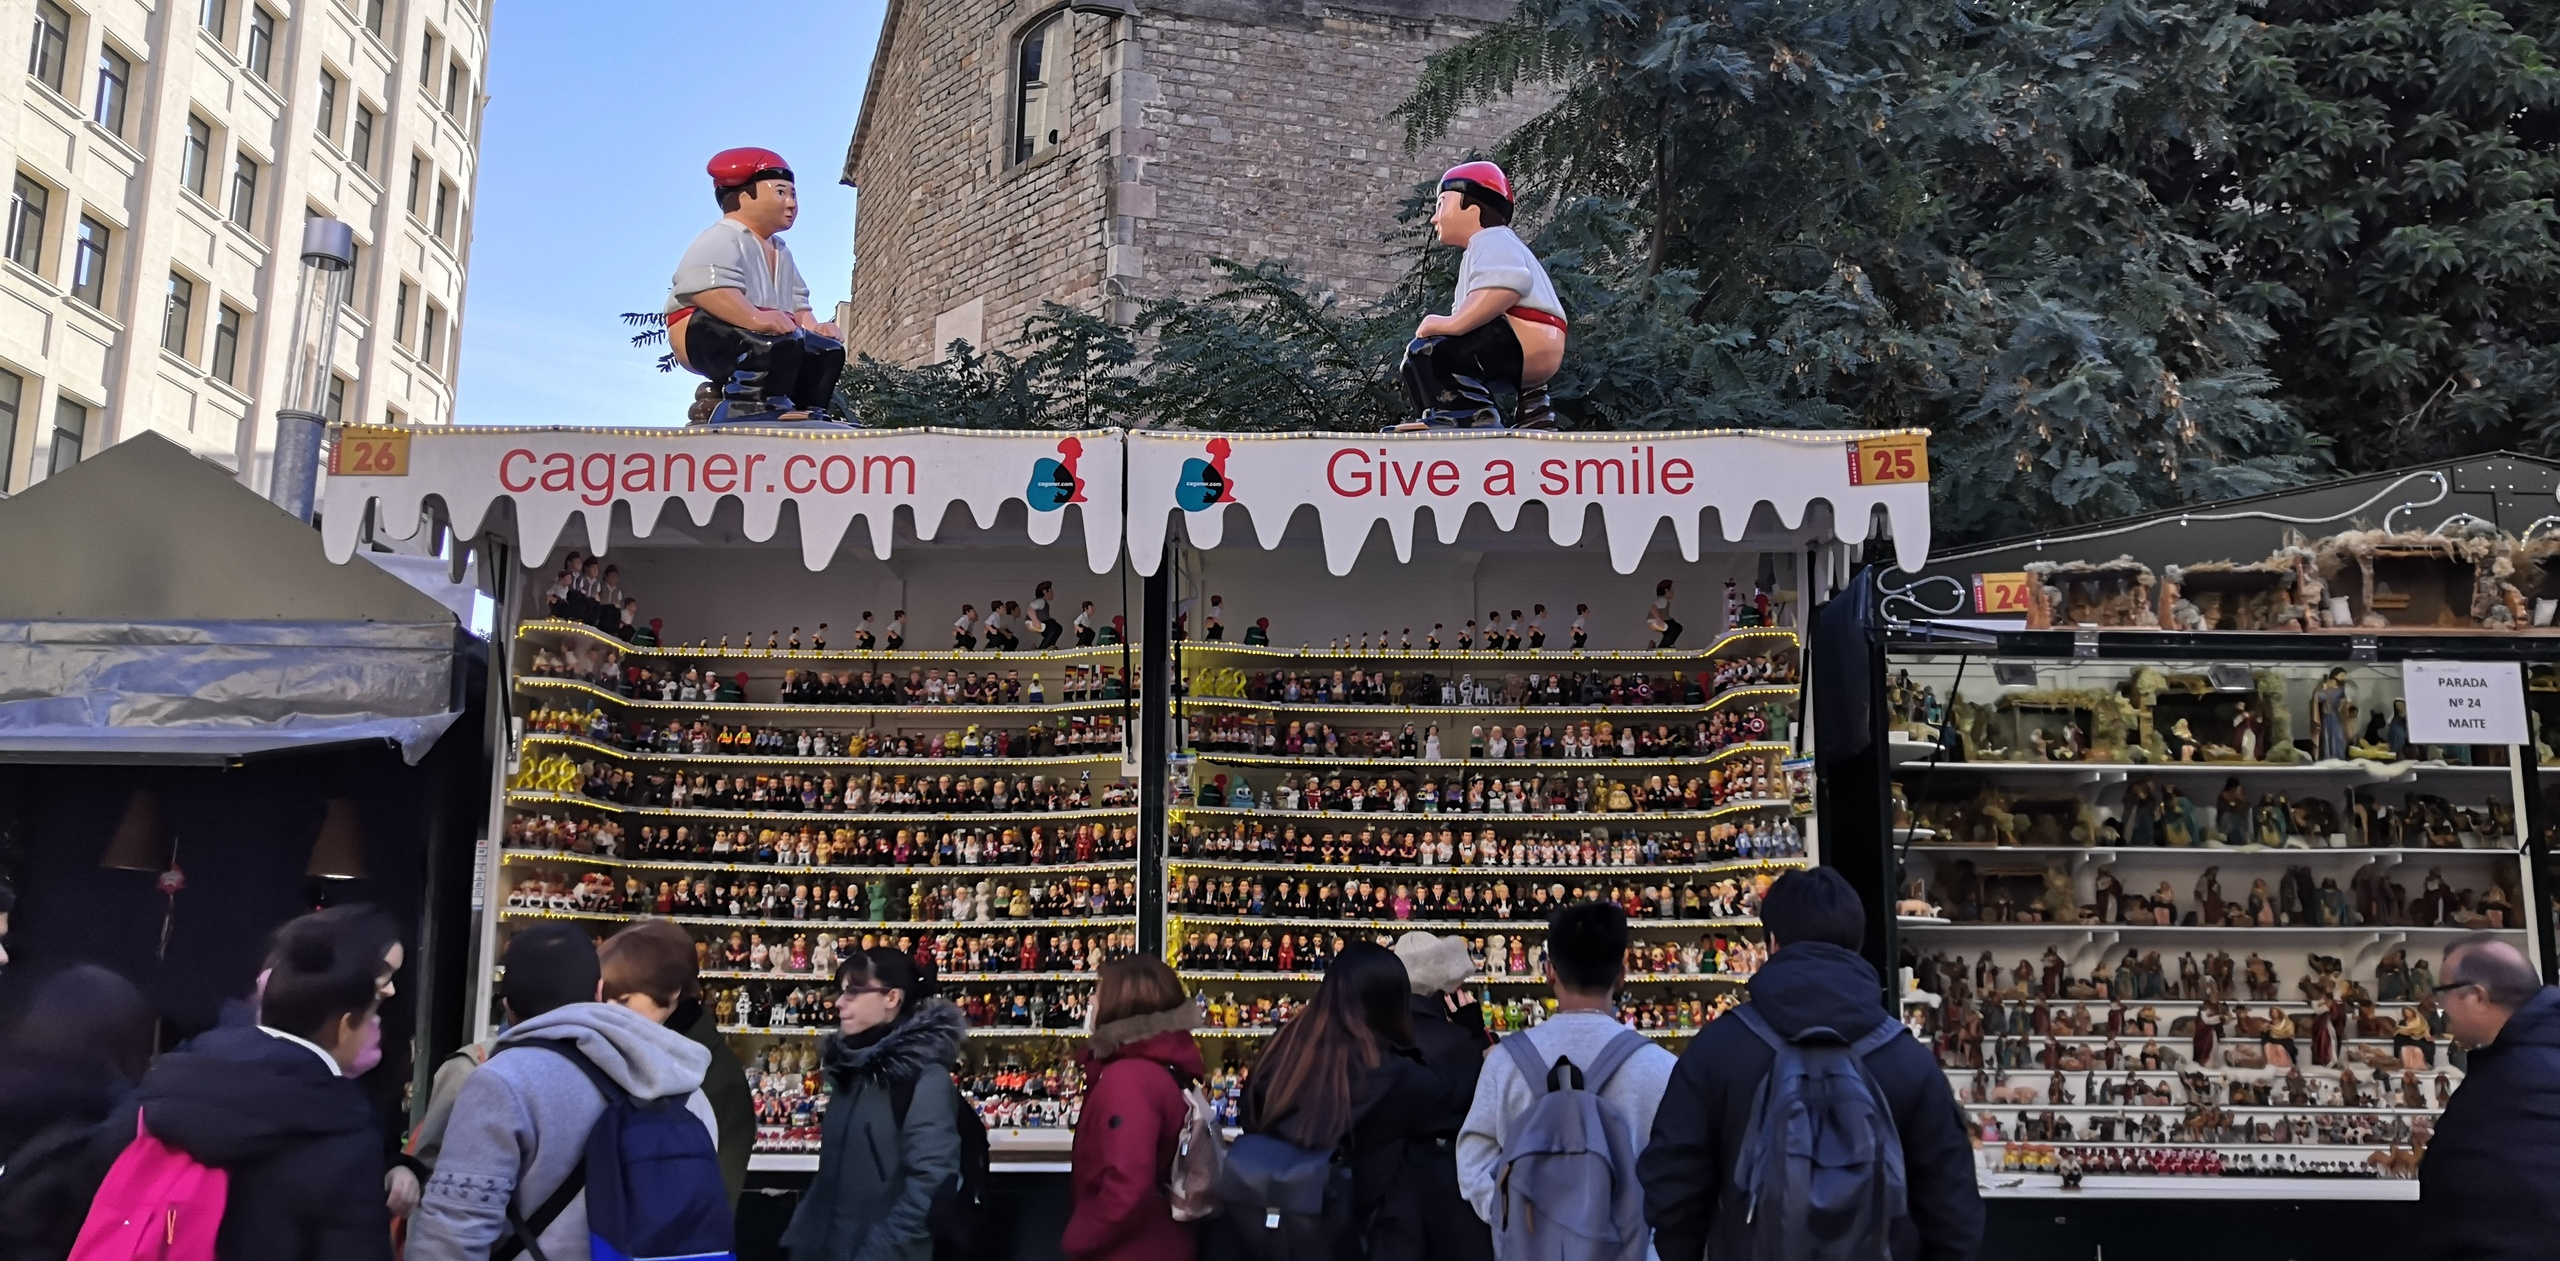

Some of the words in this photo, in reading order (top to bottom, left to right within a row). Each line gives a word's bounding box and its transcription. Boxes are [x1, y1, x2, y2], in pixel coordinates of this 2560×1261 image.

[352, 442, 396, 472] 26
[1873, 449, 1915, 480] 25
[500, 449, 915, 506] caganer.com
[1327, 449, 1459, 497] Give
[1484, 460, 1515, 496] a
[1540, 446, 1694, 496] smile
[1995, 584, 2030, 609] 24
[2438, 677, 2488, 688] PARADA
[2449, 698, 2464, 708] Nº
[2467, 698, 2482, 708] 24
[2448, 718, 2487, 729] MAITE
